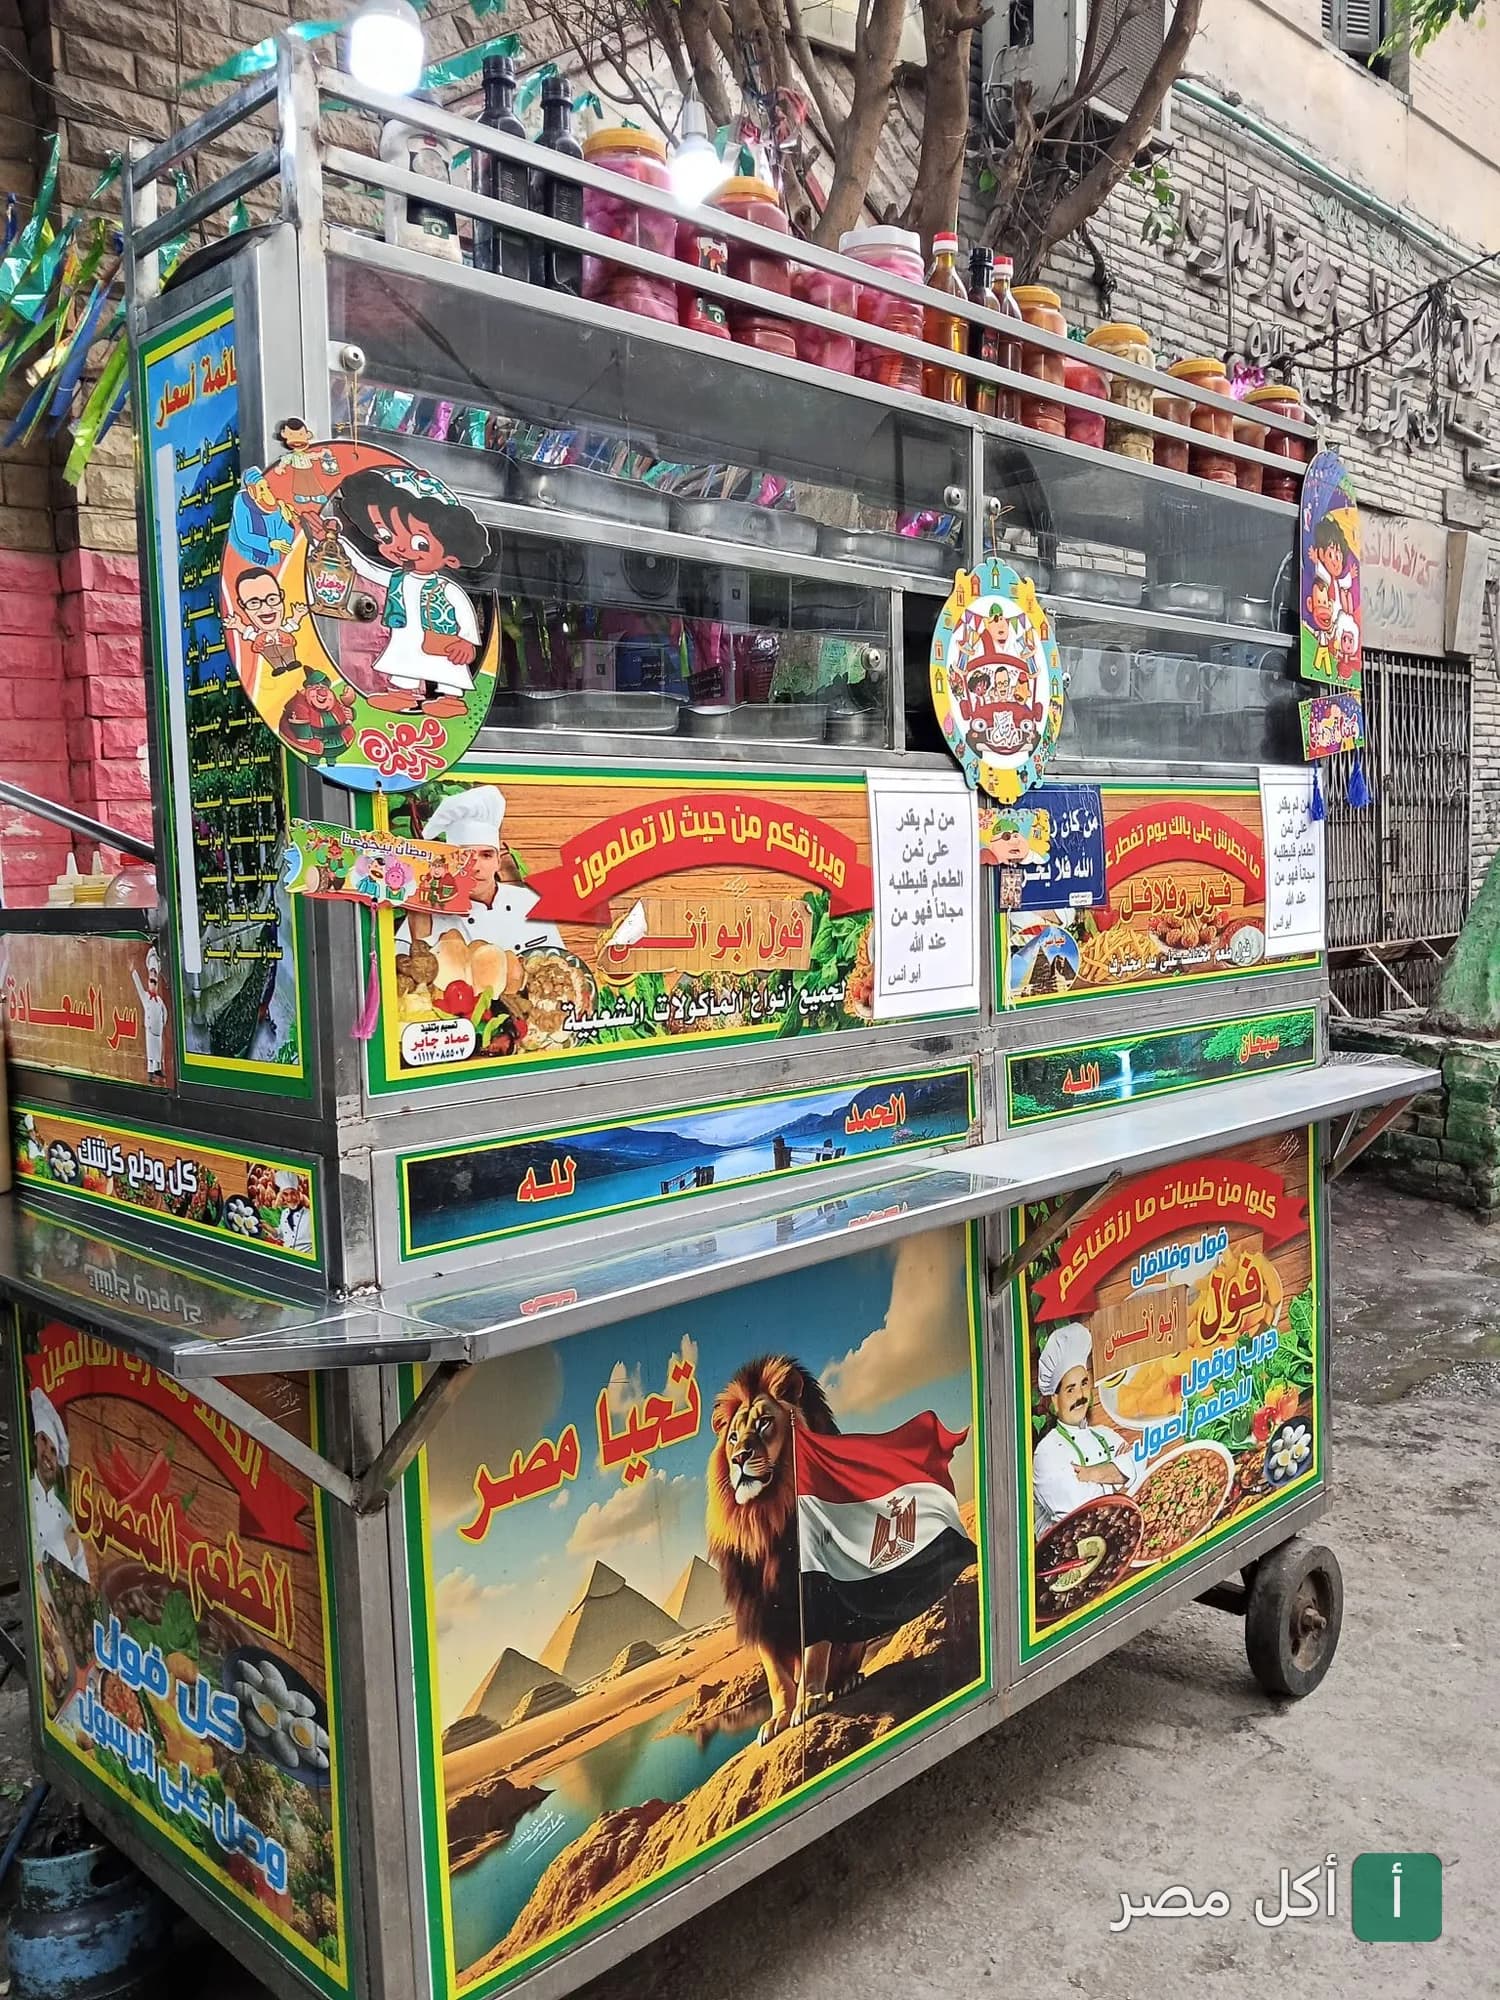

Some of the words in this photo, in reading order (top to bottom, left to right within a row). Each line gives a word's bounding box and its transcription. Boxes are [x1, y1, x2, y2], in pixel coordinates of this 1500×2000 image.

[155, 360, 196, 429] أسعار
[359, 717, 447, 764] رمضان
[378, 748, 447, 781] كريم
[658, 809, 676, 844] لا
[679, 804, 727, 843] حيث
[730, 804, 762, 844] من
[896, 808, 920, 833] يقدر
[923, 808, 935, 836] لم
[938, 813, 955, 832] من
[1060, 808, 1080, 838] كان
[1083, 810, 1099, 838] من
[1146, 820, 1167, 847] يوم
[1168, 815, 1191, 842] بالك
[1193, 820, 1212, 845] على
[341, 830, 392, 856] بيجمعنا
[395, 842, 432, 861] رمضان
[572, 815, 657, 900] تعلمون
[766, 820, 846, 889] ويرزقكم
[902, 837, 924, 863] ثمن
[927, 839, 949, 865] على
[1115, 823, 1145, 866] تفطر
[889, 870, 928, 896] فليطلبه
[931, 869, 964, 896] الطعام
[1054, 855, 1071, 881] فلا
[1073, 851, 1093, 878] الله
[911, 899, 932, 927] فهو
[1119, 875, 1188, 924] وفلافل
[1193, 872, 1234, 920] فول
[710, 906, 754, 963] أبو
[758, 908, 805, 961] فول
[890, 907, 908, 928] من
[909, 933, 925, 954] الله
[928, 933, 946, 952] عند
[888, 966, 907, 986] أنس
[909, 963, 921, 985] أبو
[7, 975, 104, 1033] السعادة
[652, 988, 744, 1025] المأكولات
[750, 985, 793, 1020] أنواع
[799, 979, 846, 1015] لجميع
[107, 1005, 138, 1050] سر
[562, 998, 645, 1039] الشعبية
[410, 1036, 439, 1051] جابر
[444, 1033, 470, 1045] عماد
[1239, 1030, 1280, 1064] سبحان
[1062, 1061, 1100, 1094] الله
[845, 1091, 906, 1135] الحمد
[127, 1149, 165, 1192] ودلع
[168, 1157, 198, 1196] كل
[516, 1155, 578, 1203] لله
[1135, 1197, 1156, 1223] ما
[1160, 1177, 1215, 1211] طيبات
[1217, 1177, 1242, 1207] من
[1245, 1182, 1277, 1220] كلوا
[1058, 1210, 1132, 1303] رزقناكم
[1194, 1226, 1228, 1264] فول
[1131, 1242, 1191, 1289] وفلافل
[1199, 1256, 1263, 1342] فول
[1104, 1304, 1154, 1361] أنس
[1156, 1297, 1179, 1343] أبو
[41, 1331, 118, 1393] العالمين
[1239, 1328, 1279, 1365] جرب
[1181, 1346, 1238, 1398] وقول
[595, 1360, 702, 1486] تحيا
[1190, 1375, 1253, 1439] للطعم
[1133, 1400, 1188, 1463] أصول
[457, 1423, 581, 1543] مصر
[188, 1530, 296, 1650] الطعم
[175, 1672, 247, 1753] كل
[76, 1685, 155, 1783] الرسول
[158, 1760, 211, 1828] على
[212, 1797, 288, 1895] وصل
